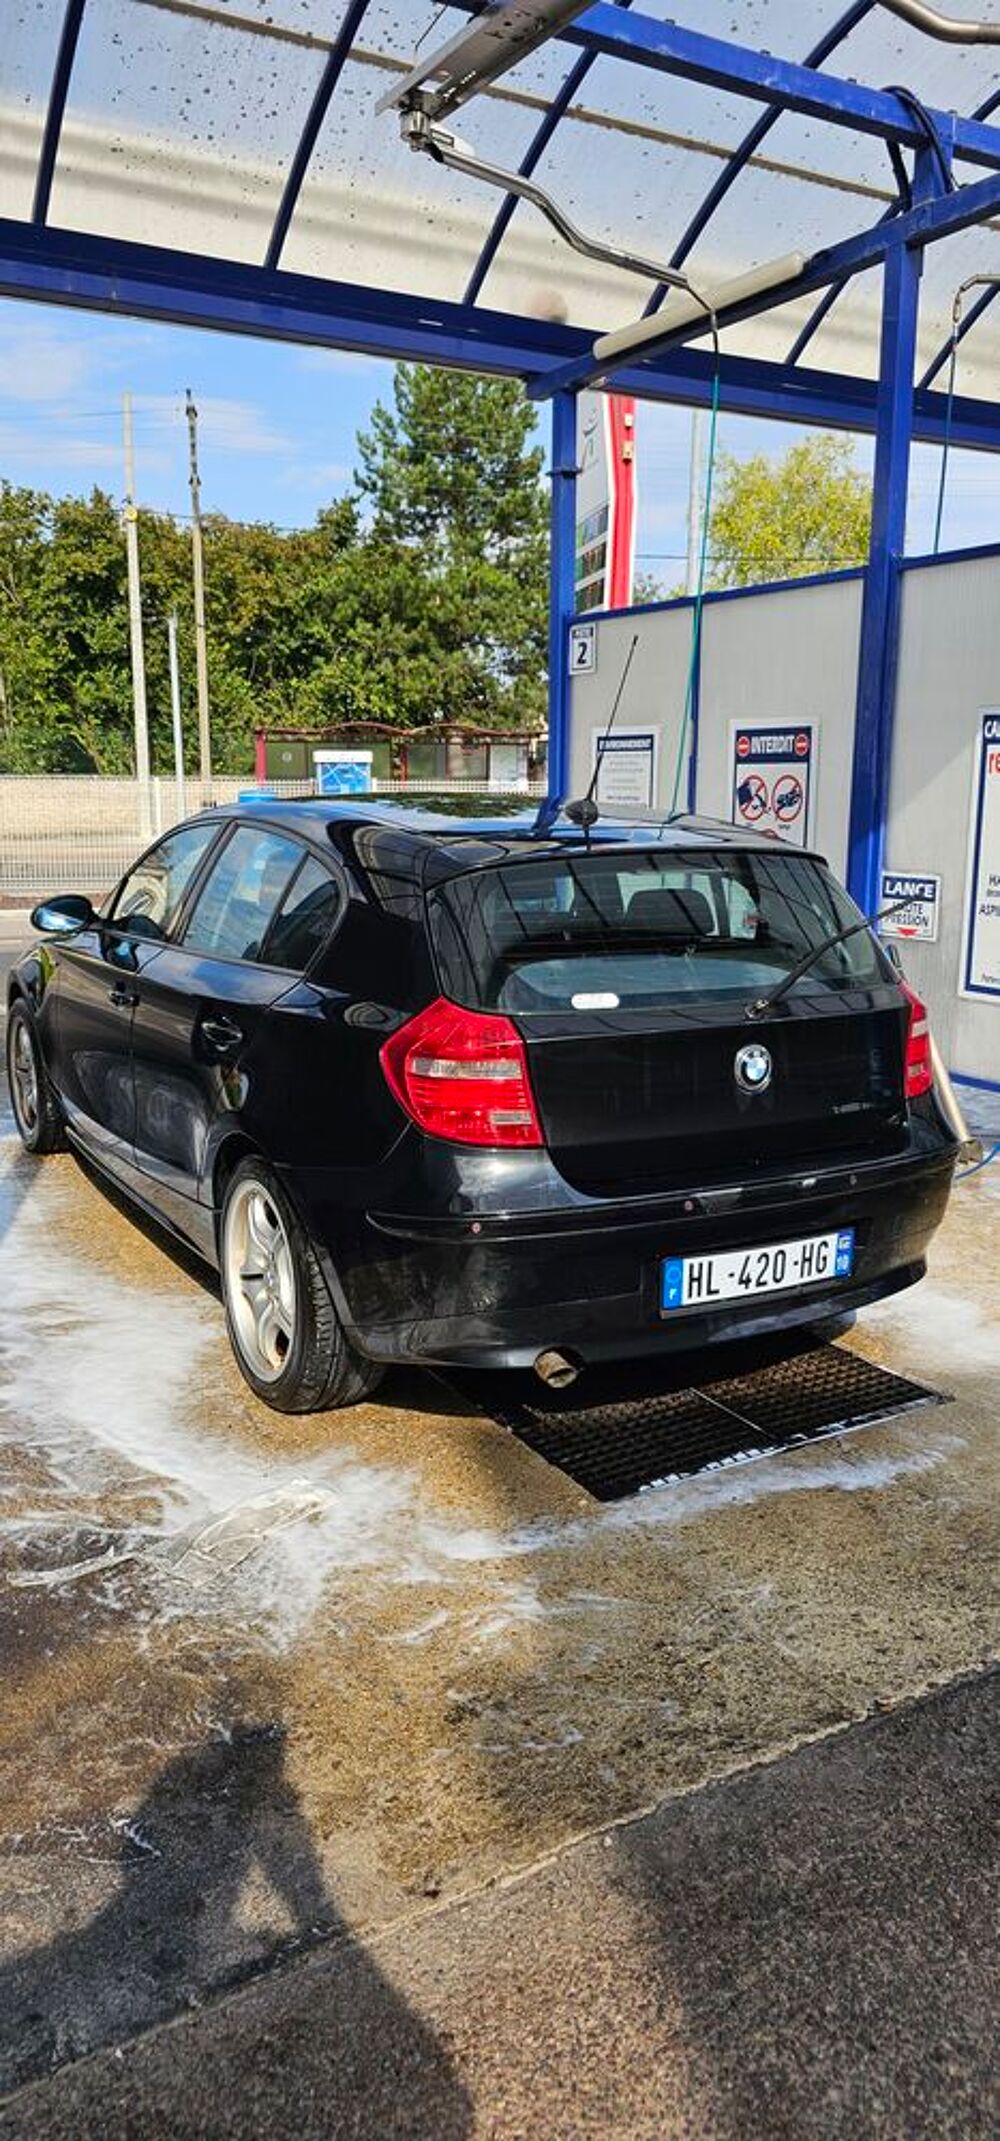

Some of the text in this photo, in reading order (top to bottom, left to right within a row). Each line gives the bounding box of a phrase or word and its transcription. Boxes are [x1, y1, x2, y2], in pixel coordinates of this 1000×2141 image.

[577, 642, 588, 664] 2
[751, 735, 795, 754] INTERDIT
[885, 881, 934, 897] LANCE
